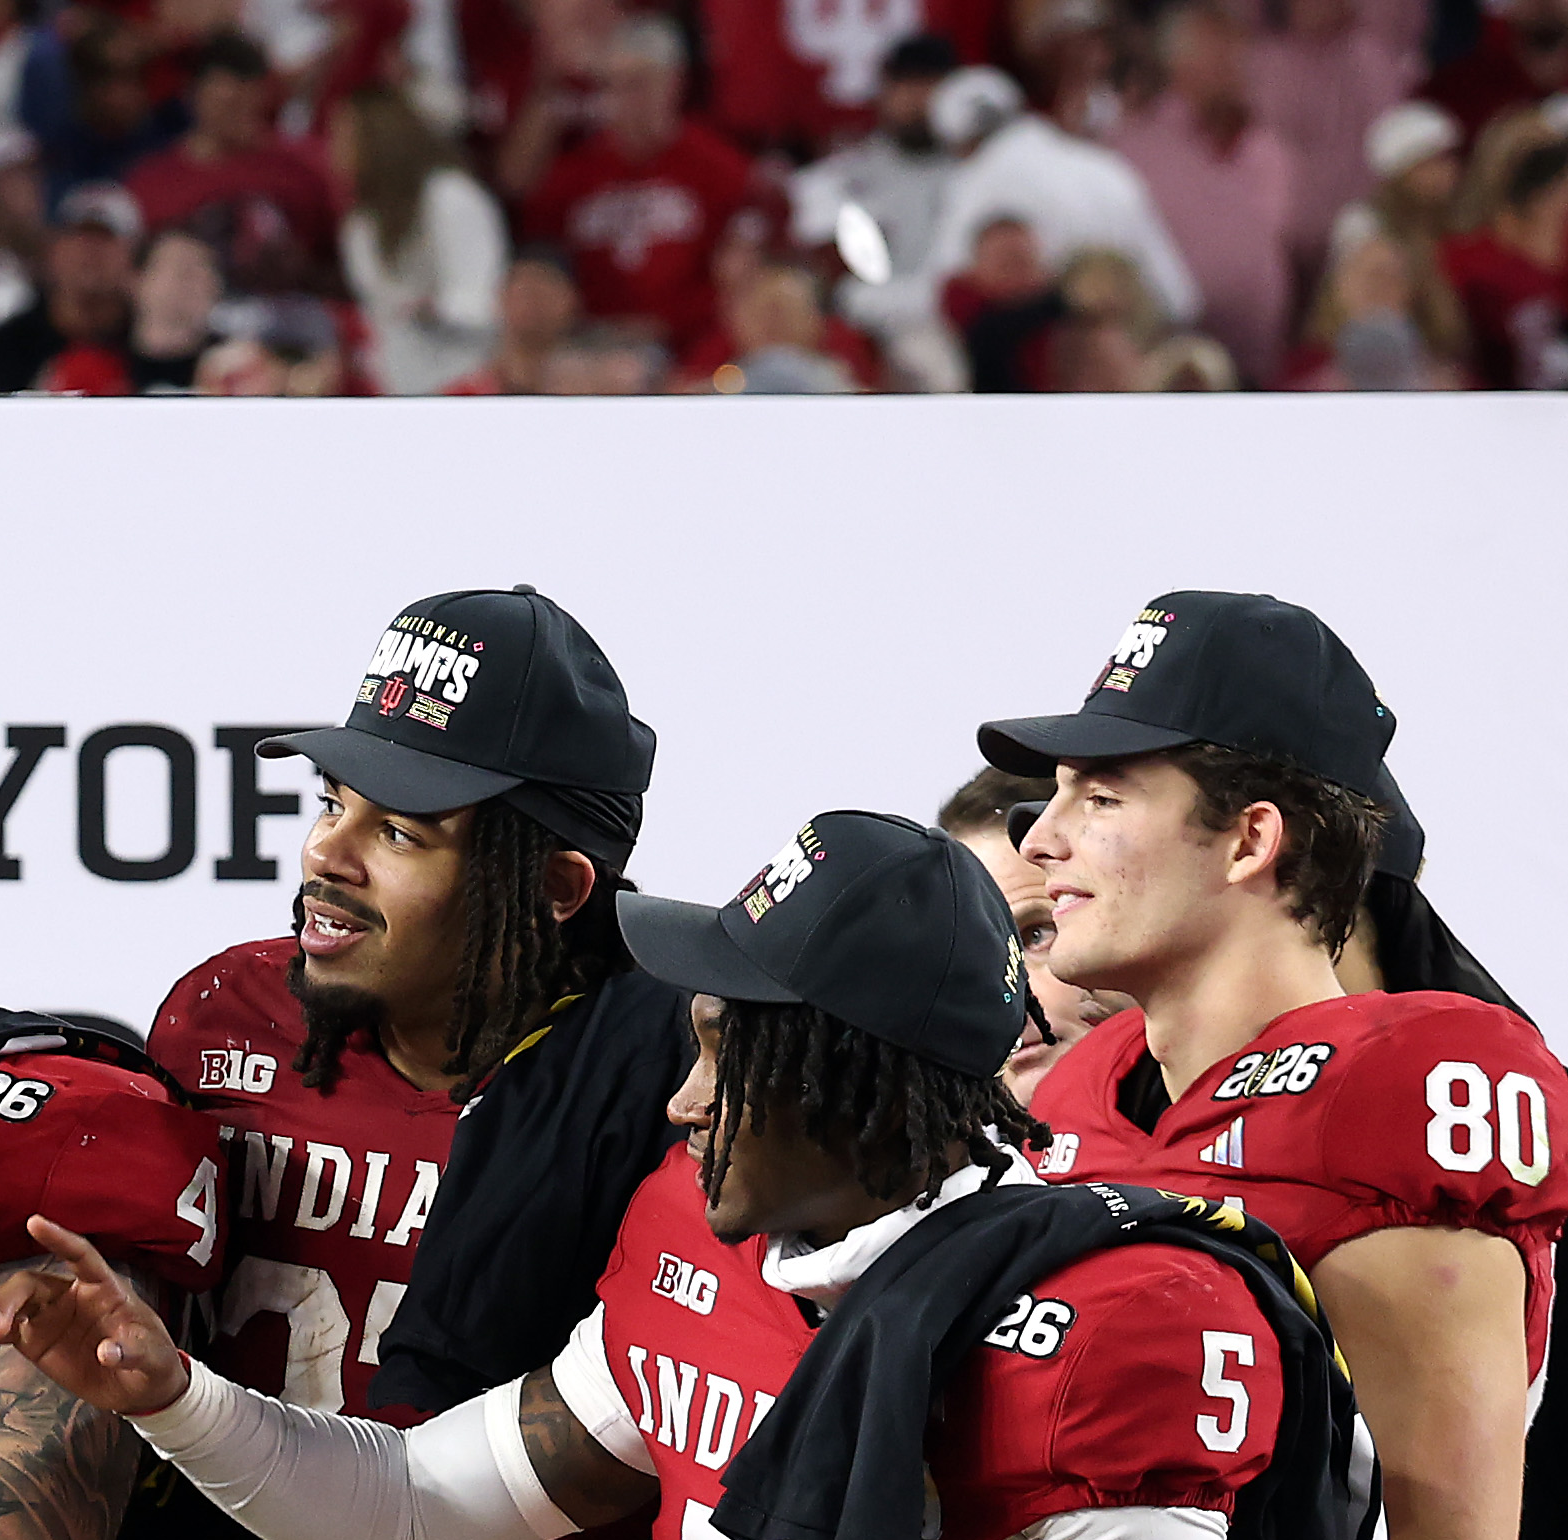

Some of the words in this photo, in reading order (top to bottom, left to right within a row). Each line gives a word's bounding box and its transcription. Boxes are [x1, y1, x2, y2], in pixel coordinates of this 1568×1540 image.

[1425, 1060, 1552, 1188] 80
[176, 1155, 219, 1267] 4
[1196, 1330, 1256, 1453] 5
